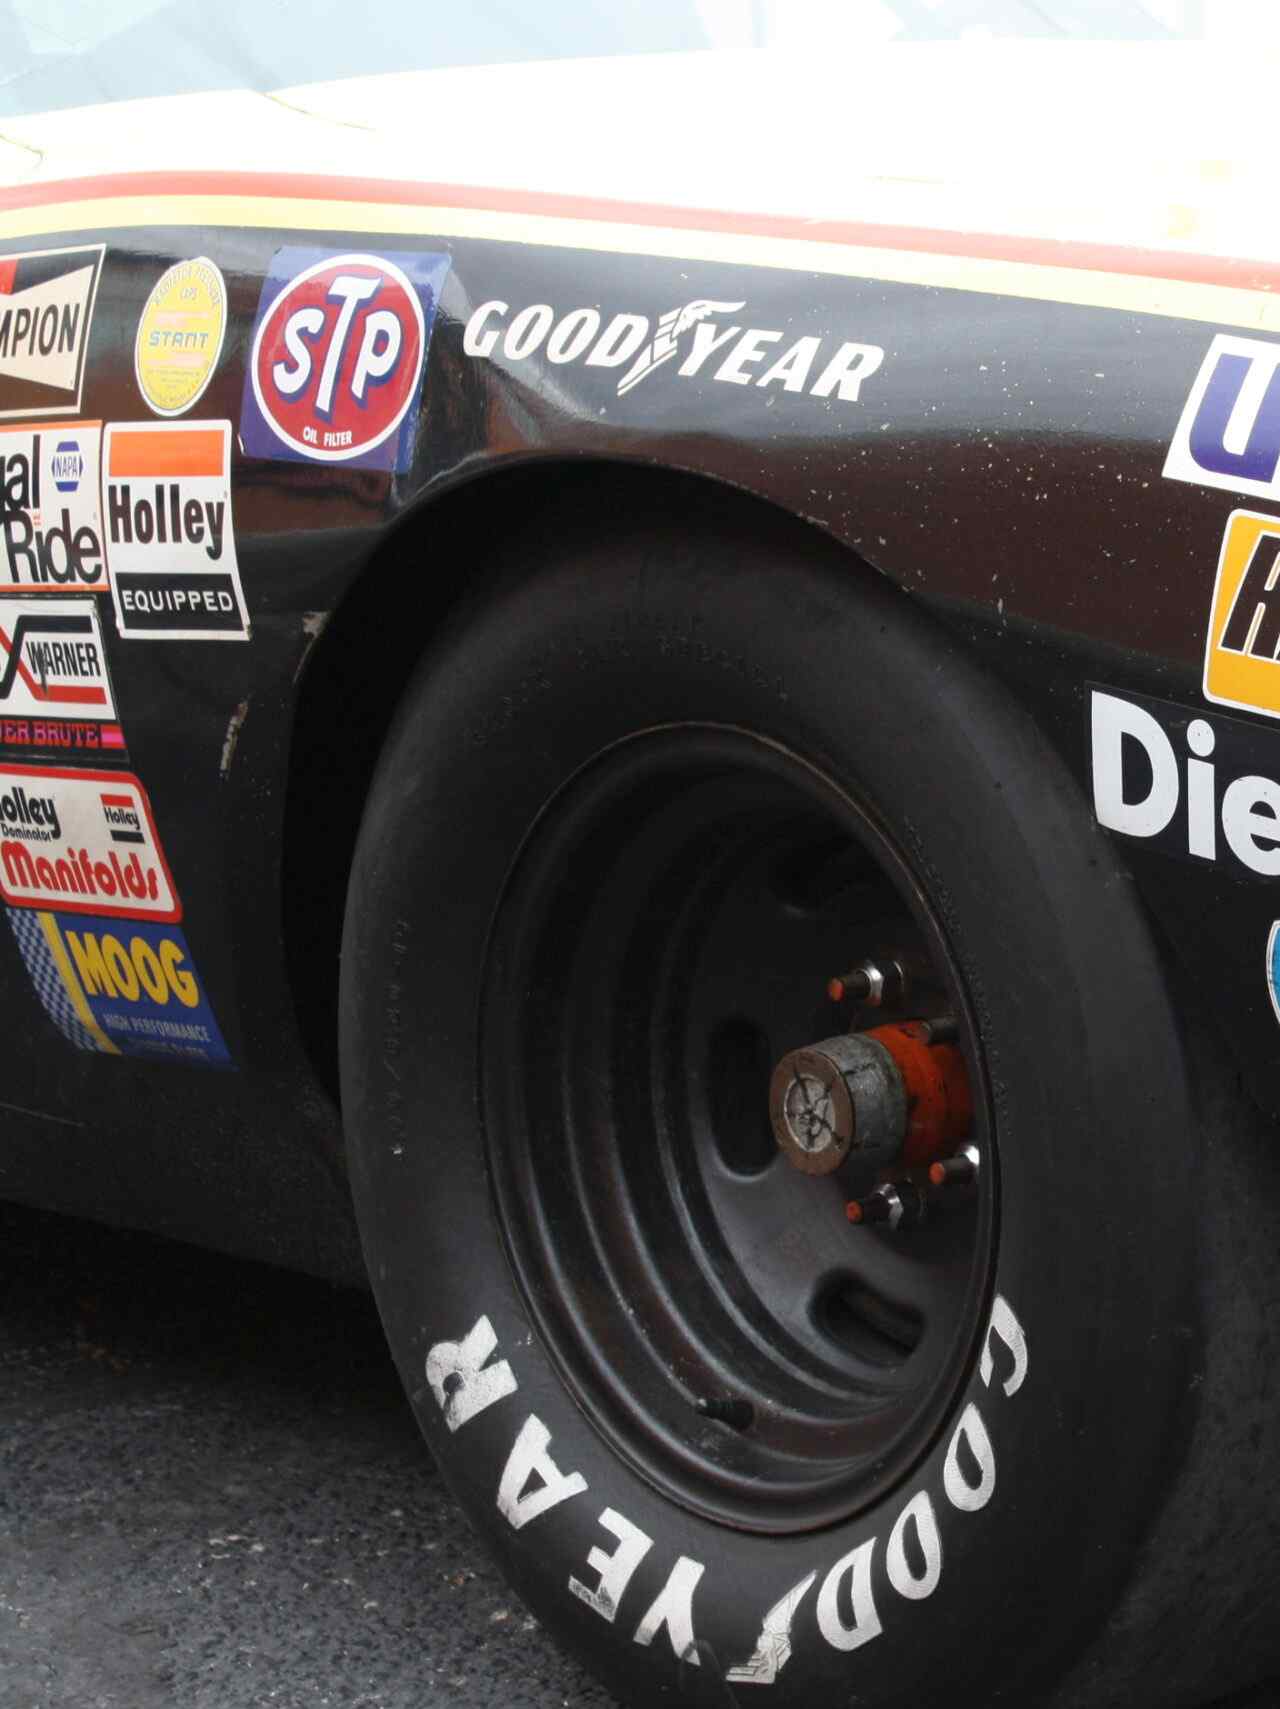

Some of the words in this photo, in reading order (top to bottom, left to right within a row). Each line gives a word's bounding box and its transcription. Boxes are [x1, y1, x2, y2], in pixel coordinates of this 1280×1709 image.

[272, 275, 404, 418] STP
[462, 298, 886, 402] GOODYEAR
[303, 426, 318, 444] OIL
[324, 430, 353, 447] FILTER
[55, 455, 79, 478] NAPA
[108, 484, 225, 560] Holley
[5, 508, 102, 584] Ride
[121, 589, 233, 613] EQUIPPED
[26, 641, 101, 677] WARNER
[32, 720, 98, 748] BRUTE
[0, 787, 61, 840] olley
[104, 807, 141, 830] Holley
[1, 823, 51, 841] Dominator
[1, 840, 158, 900] Manifolds
[65, 930, 199, 1008] MOOG
[130, 1016, 211, 1042] PERFORMANCE
